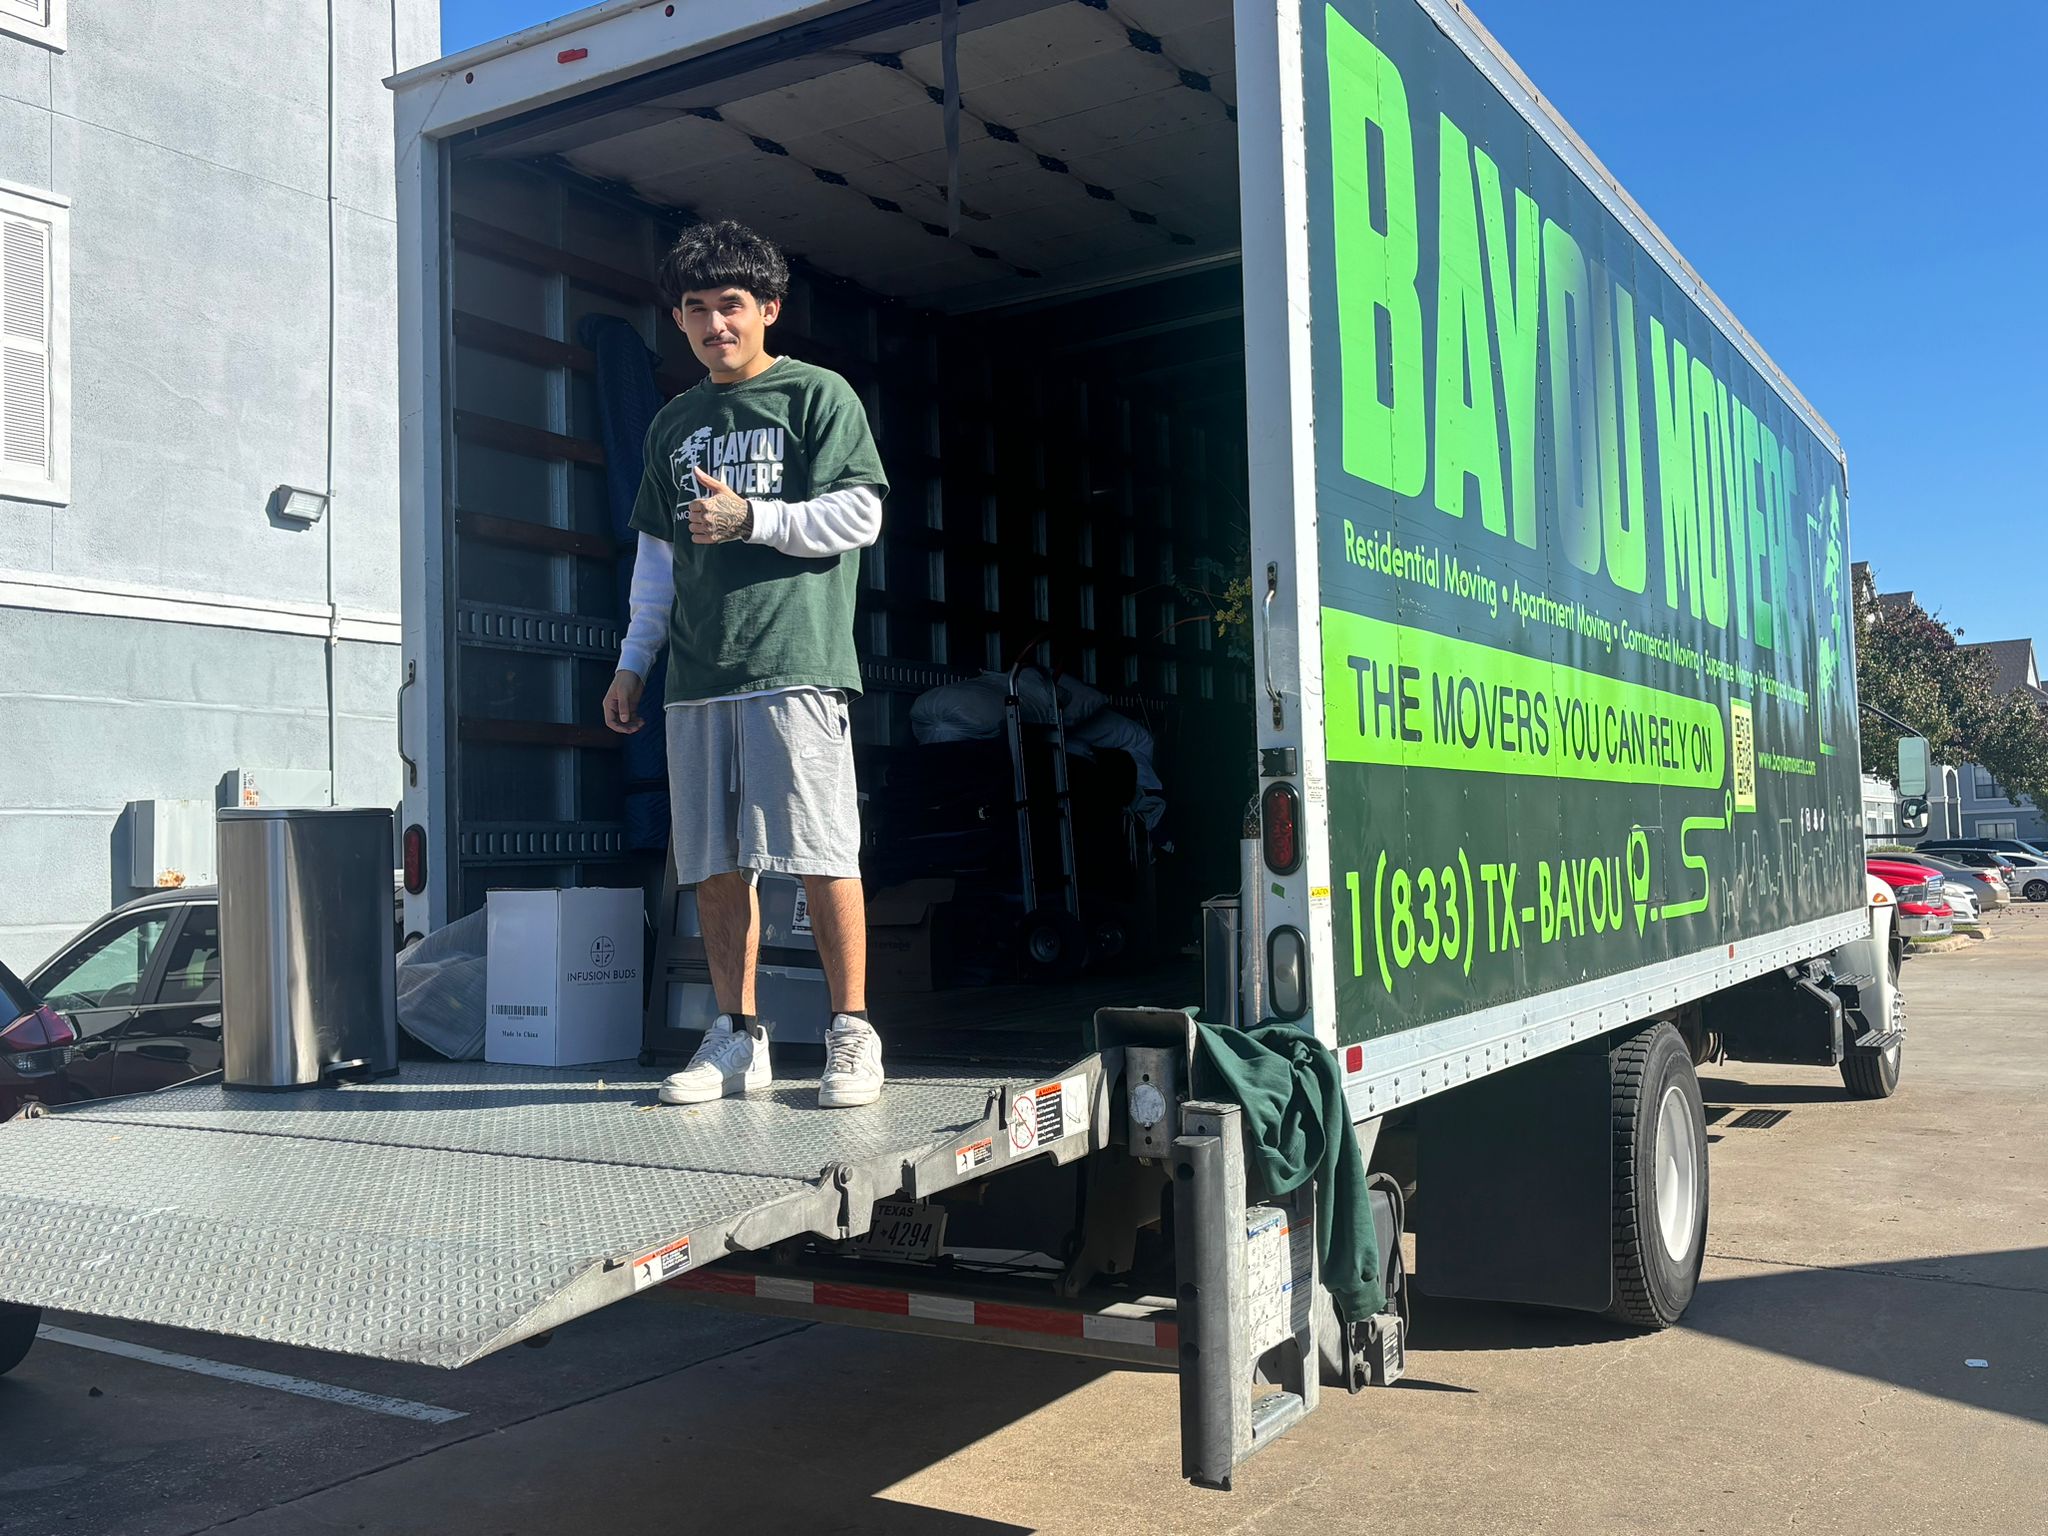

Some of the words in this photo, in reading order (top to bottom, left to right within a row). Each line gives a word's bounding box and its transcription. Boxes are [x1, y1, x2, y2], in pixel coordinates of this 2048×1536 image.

[1326, 3, 1645, 593] BAYOU
[713, 427, 784, 468] BAYOU
[1343, 518, 1440, 589] Residential
[1444, 554, 1498, 619] Moving
[1512, 579, 1575, 631] Apartment
[1577, 602, 1612, 654] Moving
[1621, 619, 1671, 662] Commercial
[1672, 637, 1700, 680] Moving
[1347, 655, 1423, 742] THE
[1432, 672, 1549, 757] MOVERS
[1555, 696, 1600, 762] YOU
[1605, 705, 1645, 765] CAN
[1649, 714, 1687, 770] RELY
[1691, 723, 1713, 773] ON
[1346, 871, 1363, 977] 1
[1374, 847, 1475, 994] (833)
[1480, 856, 1623, 953] TX-BAYOU
[567, 970, 611, 982] INFUSION
[613, 969, 637, 980] BUDS
[879, 1205, 914, 1217] TEXAS
[888, 1221, 932, 1247] 4294
